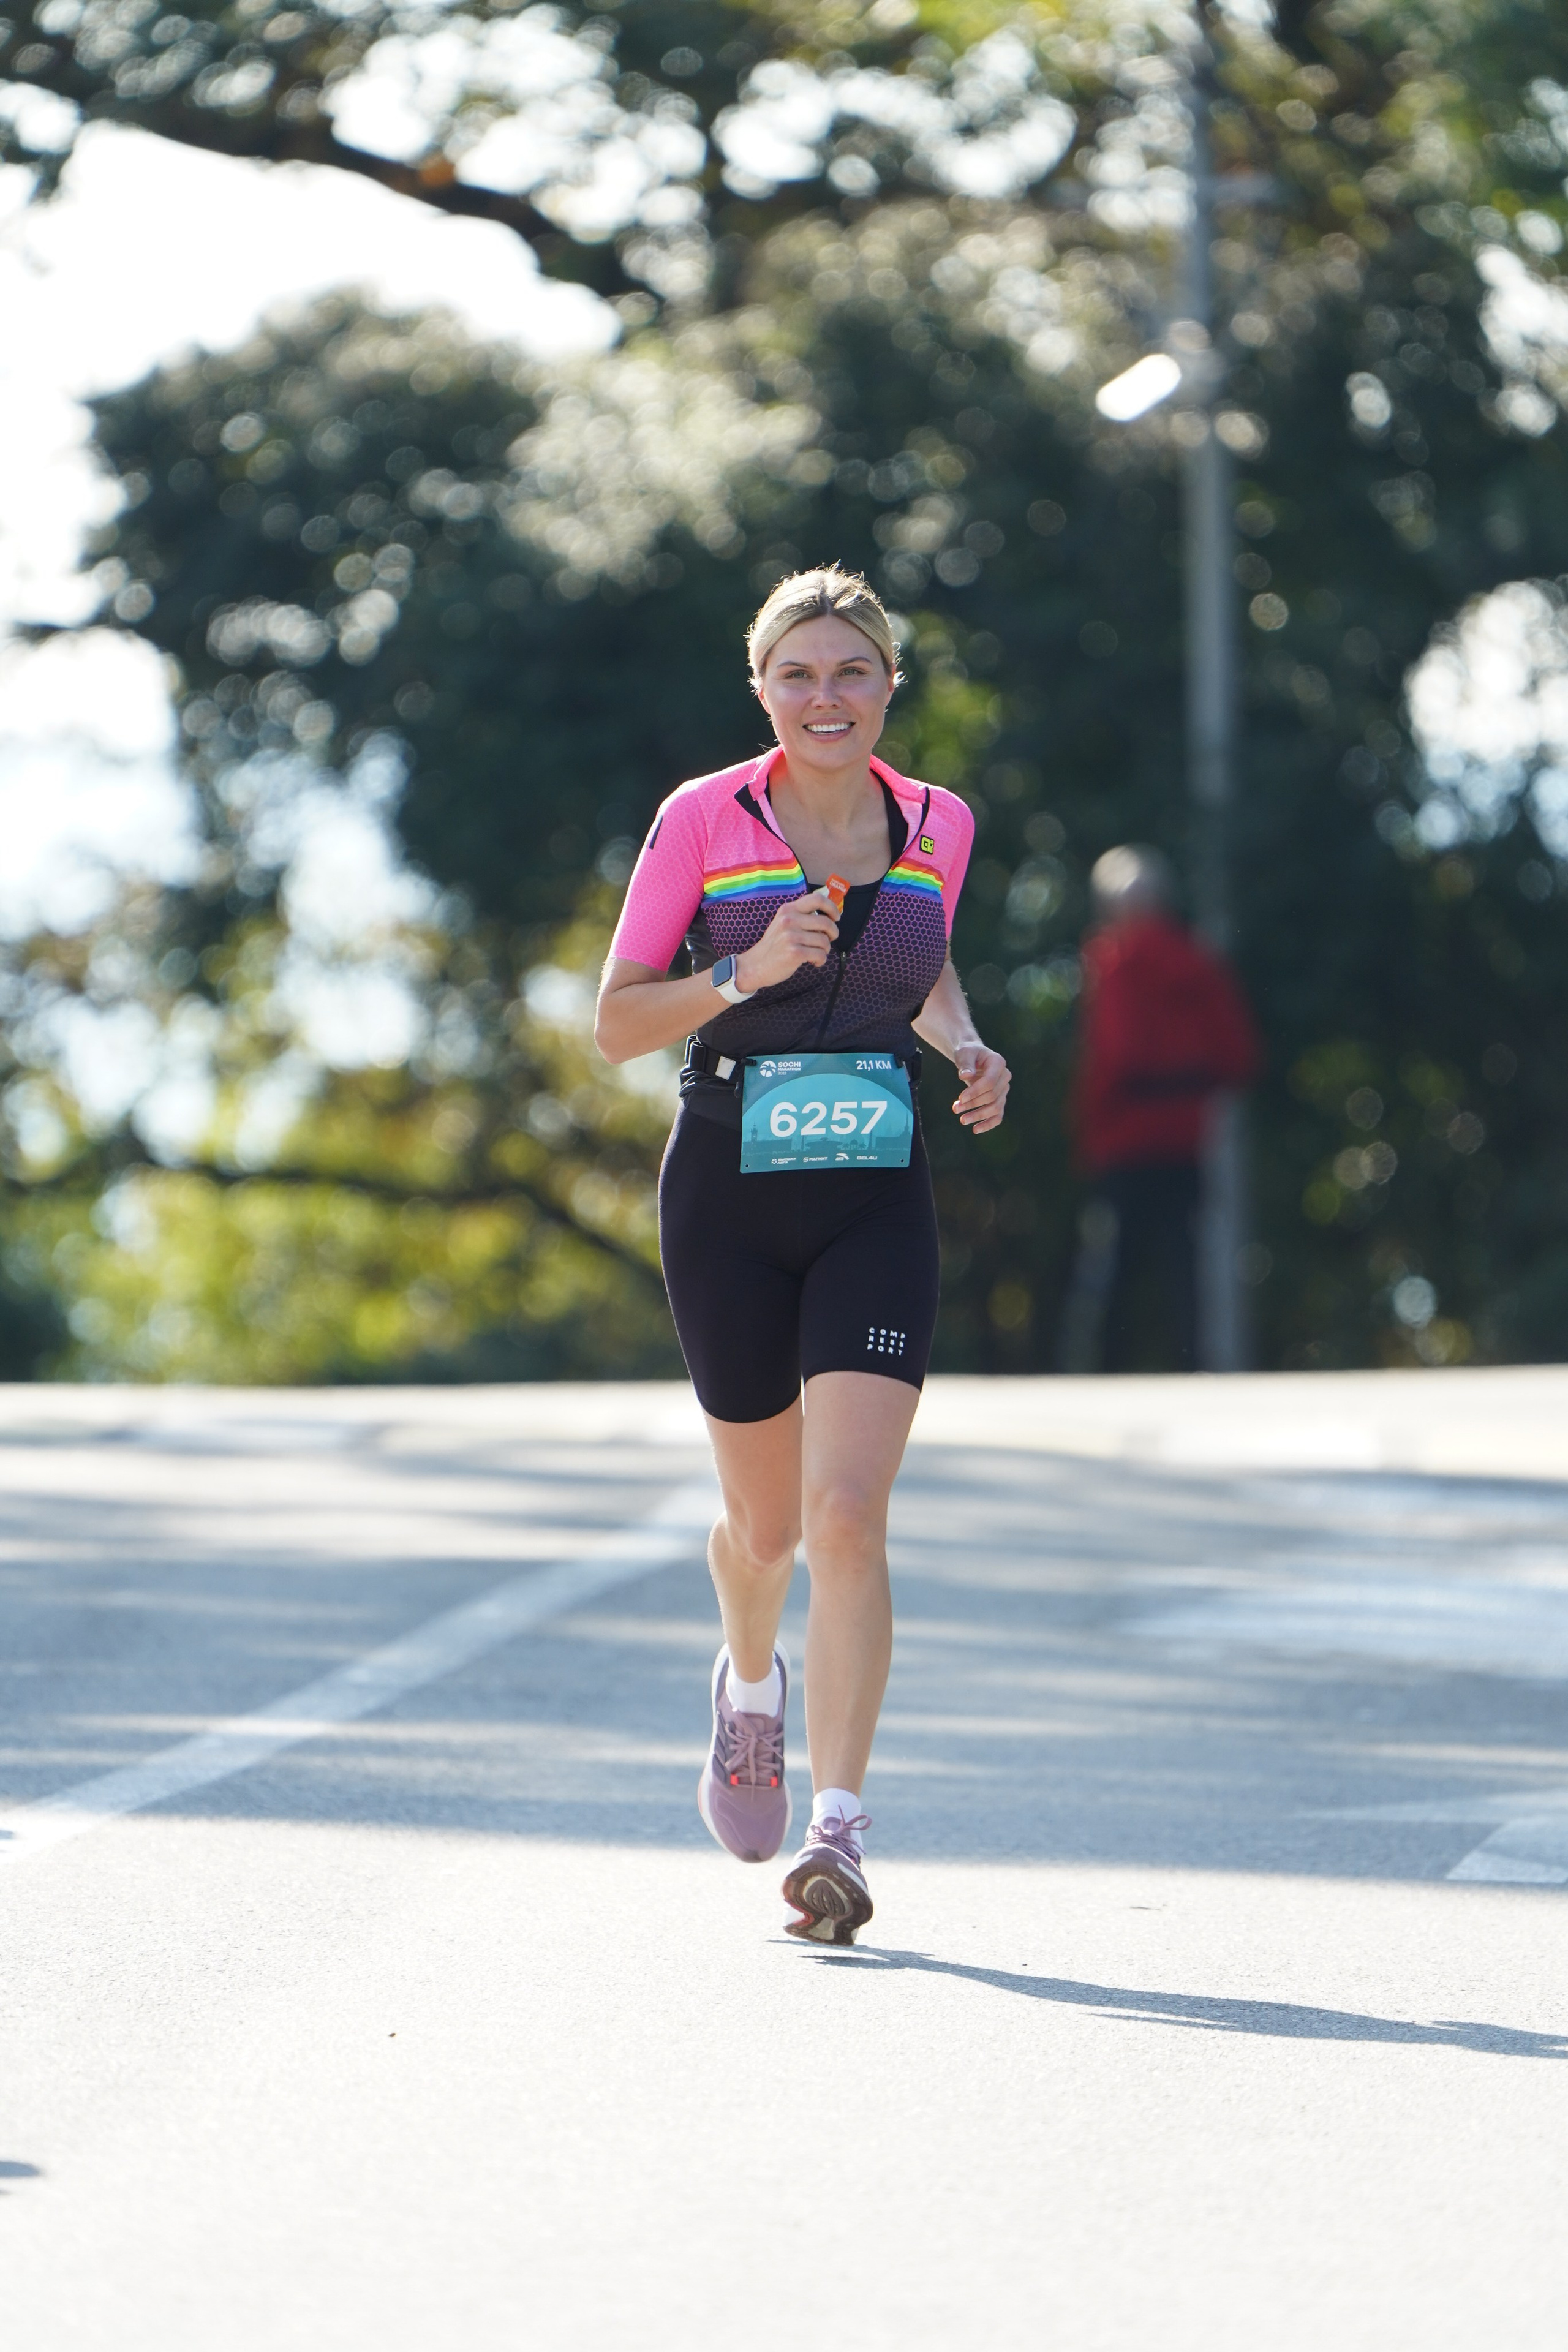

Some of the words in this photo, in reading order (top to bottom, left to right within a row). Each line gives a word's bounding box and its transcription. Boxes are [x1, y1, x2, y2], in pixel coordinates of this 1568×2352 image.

[856, 1060, 873, 1071] 21,1
[875, 1060, 892, 1069] KM
[769, 1101, 888, 1137] 6257
[869, 1327, 906, 1339] COMP
[867, 1343, 903, 1356] PORT
